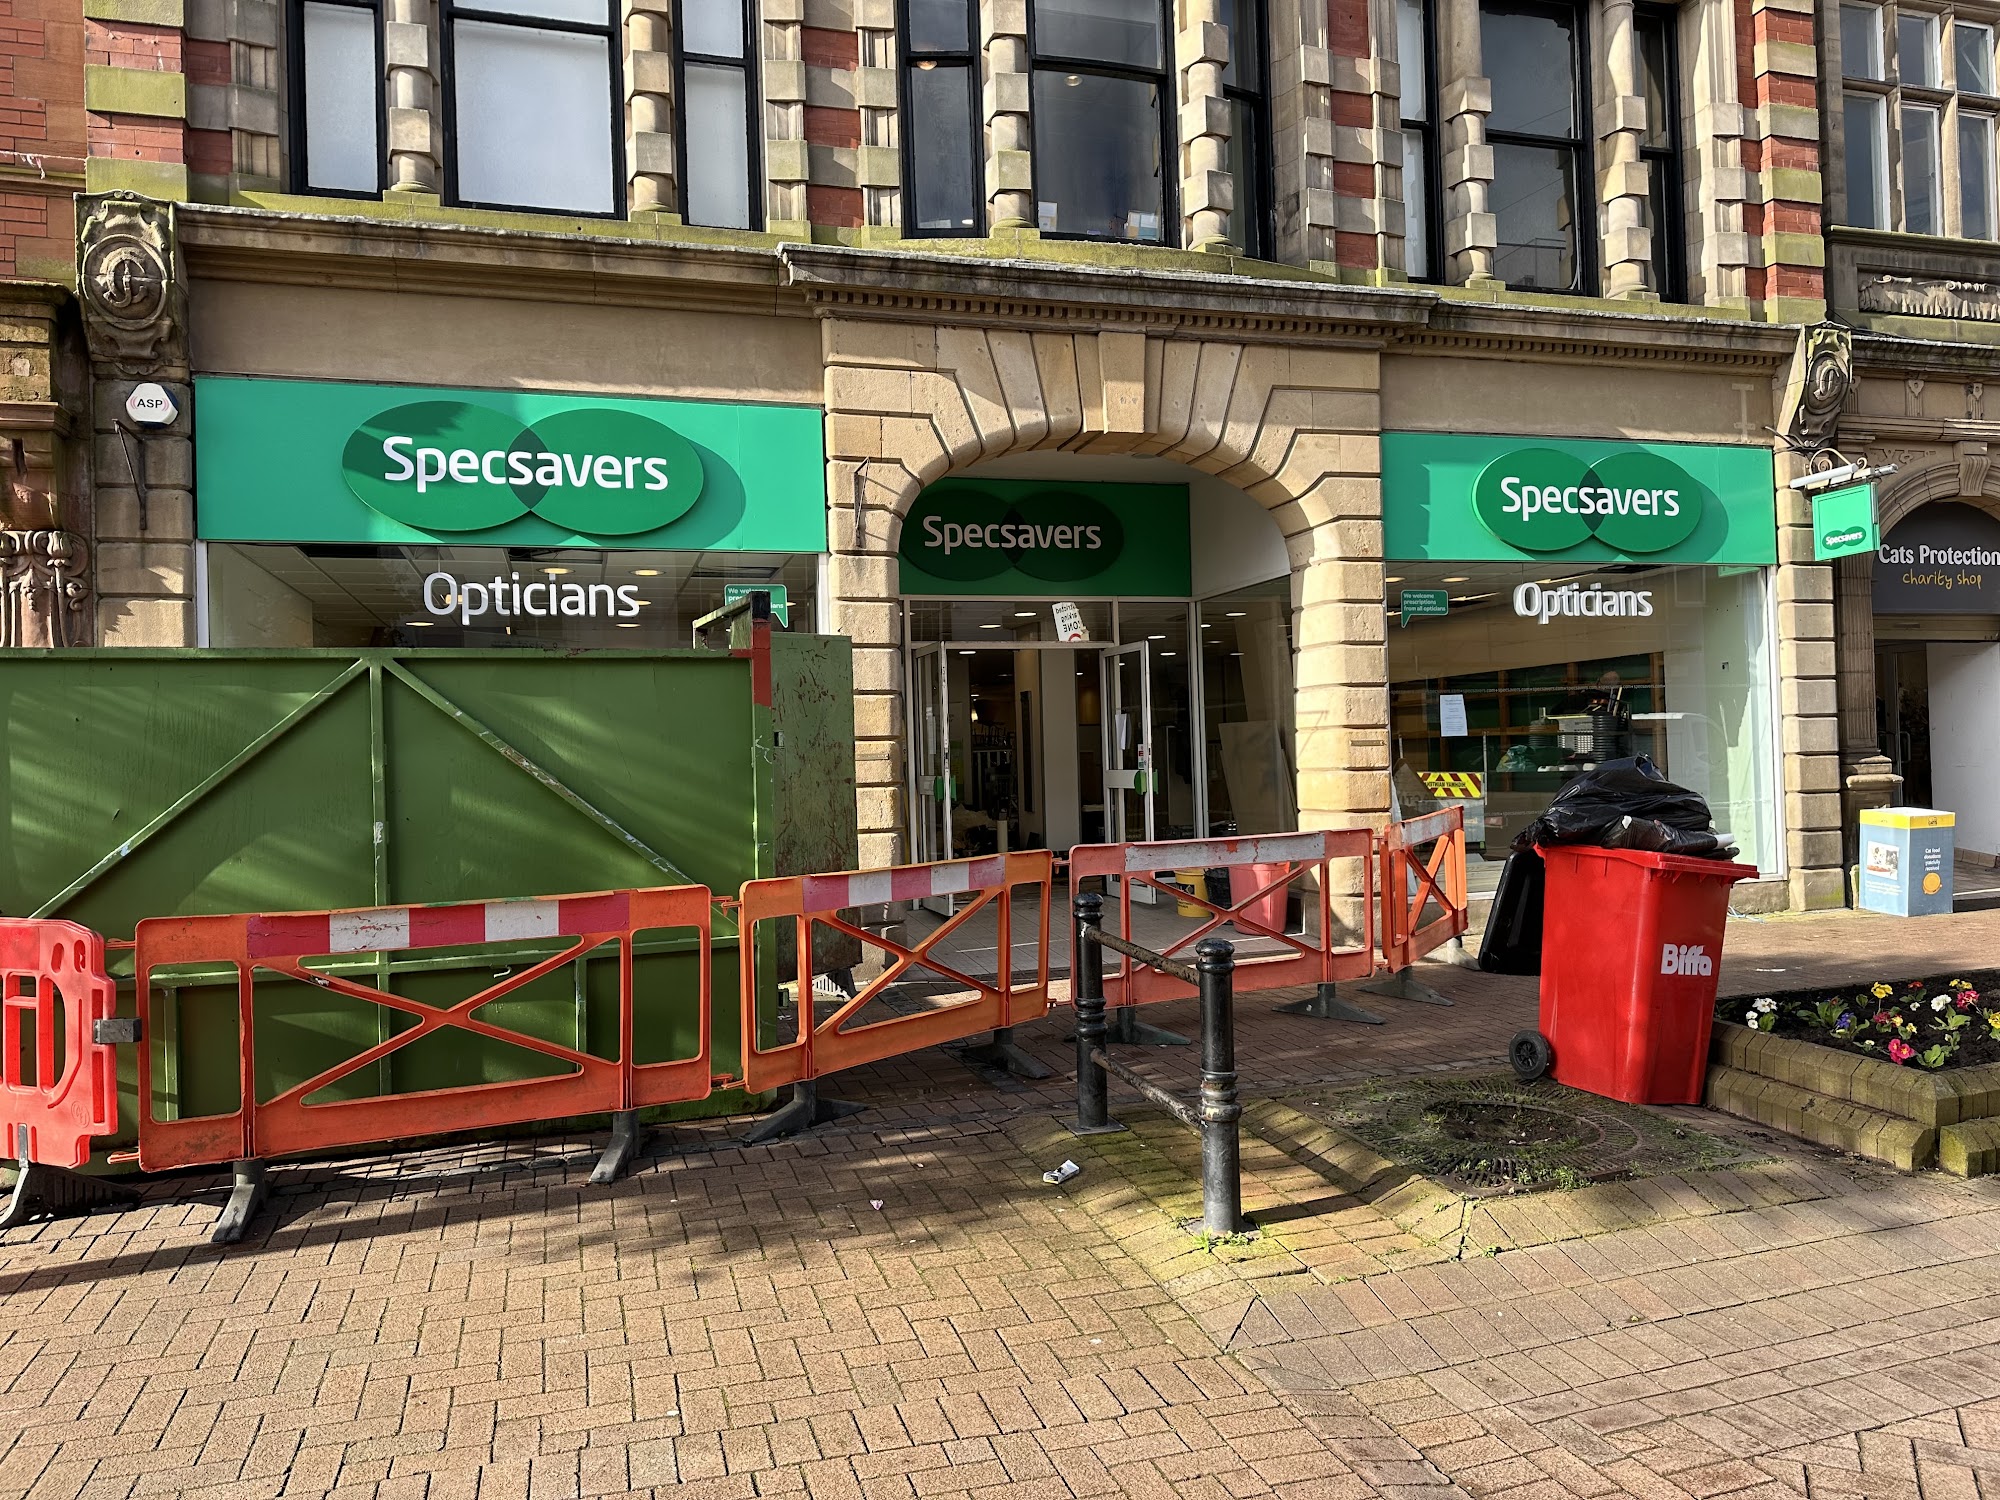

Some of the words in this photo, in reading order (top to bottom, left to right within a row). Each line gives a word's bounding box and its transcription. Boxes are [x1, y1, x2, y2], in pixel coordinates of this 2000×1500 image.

[137, 398, 163, 408] ASP
[383, 436, 669, 493] Specsavers
[1500, 476, 1680, 521] Specsavers
[922, 515, 1102, 555] Specsavers
[1825, 531, 1863, 546] Specsavers
[1879, 543, 1914, 564] Cats
[1919, 545, 2000, 566] Protection
[1902, 568, 1952, 590] charity
[1957, 568, 1982, 590] shop
[423, 572, 640, 625] Opticians
[1515, 582, 1653, 624] Opticians
[1661, 943, 1712, 976] Biffa
